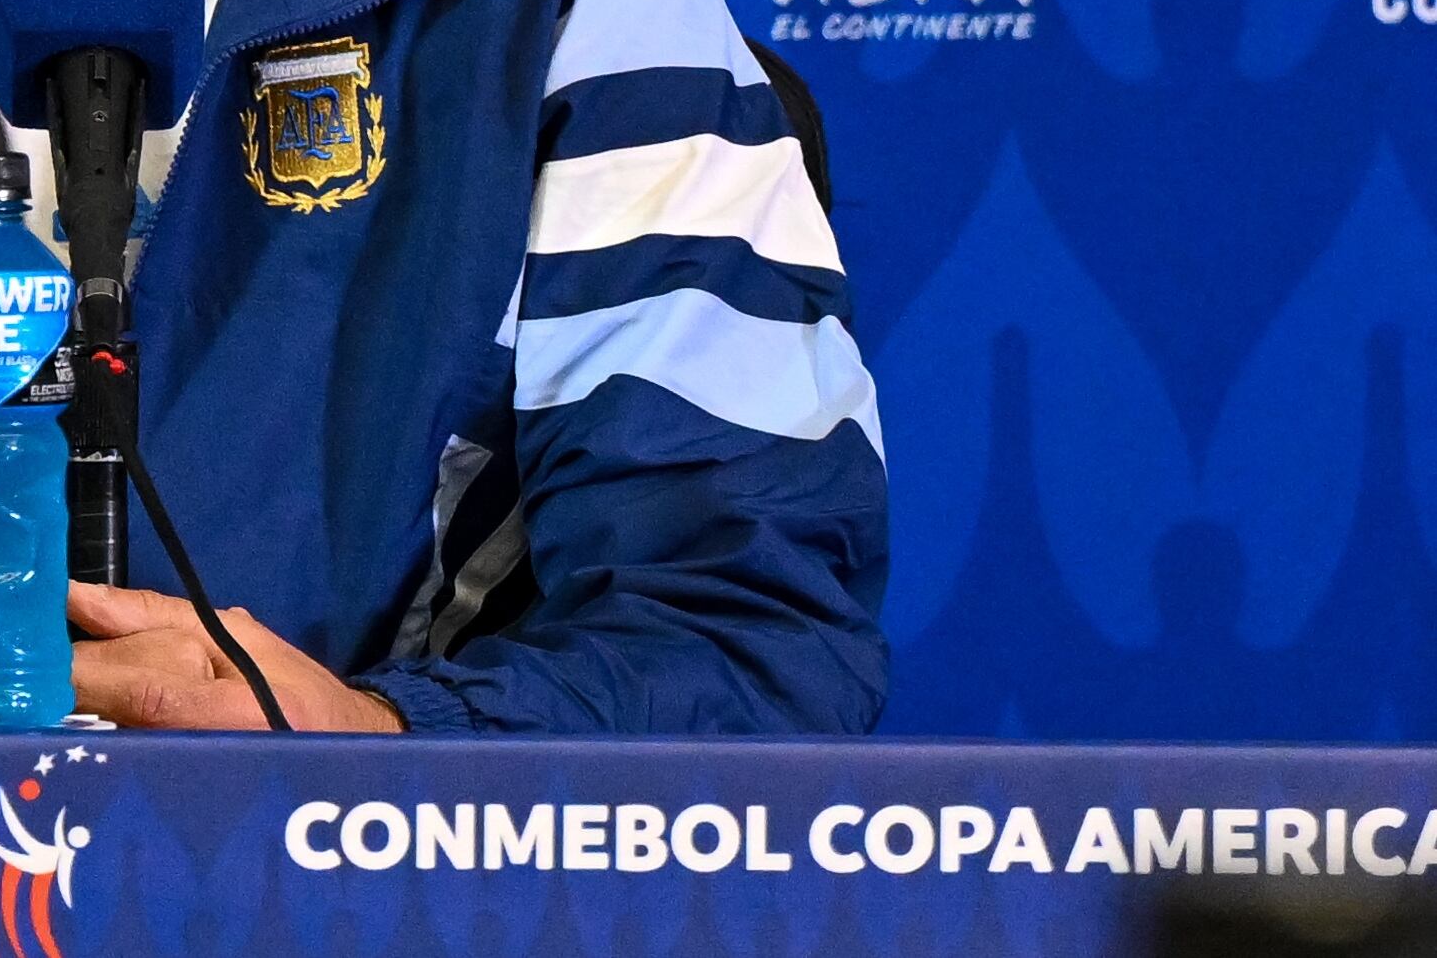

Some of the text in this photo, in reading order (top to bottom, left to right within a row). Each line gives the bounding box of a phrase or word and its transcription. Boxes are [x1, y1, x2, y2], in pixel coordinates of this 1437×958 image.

[771, 13, 1034, 41] EL CONTINENTE
[285, 802, 791, 872] CONMEBOL
[809, 805, 1053, 873] COPA
